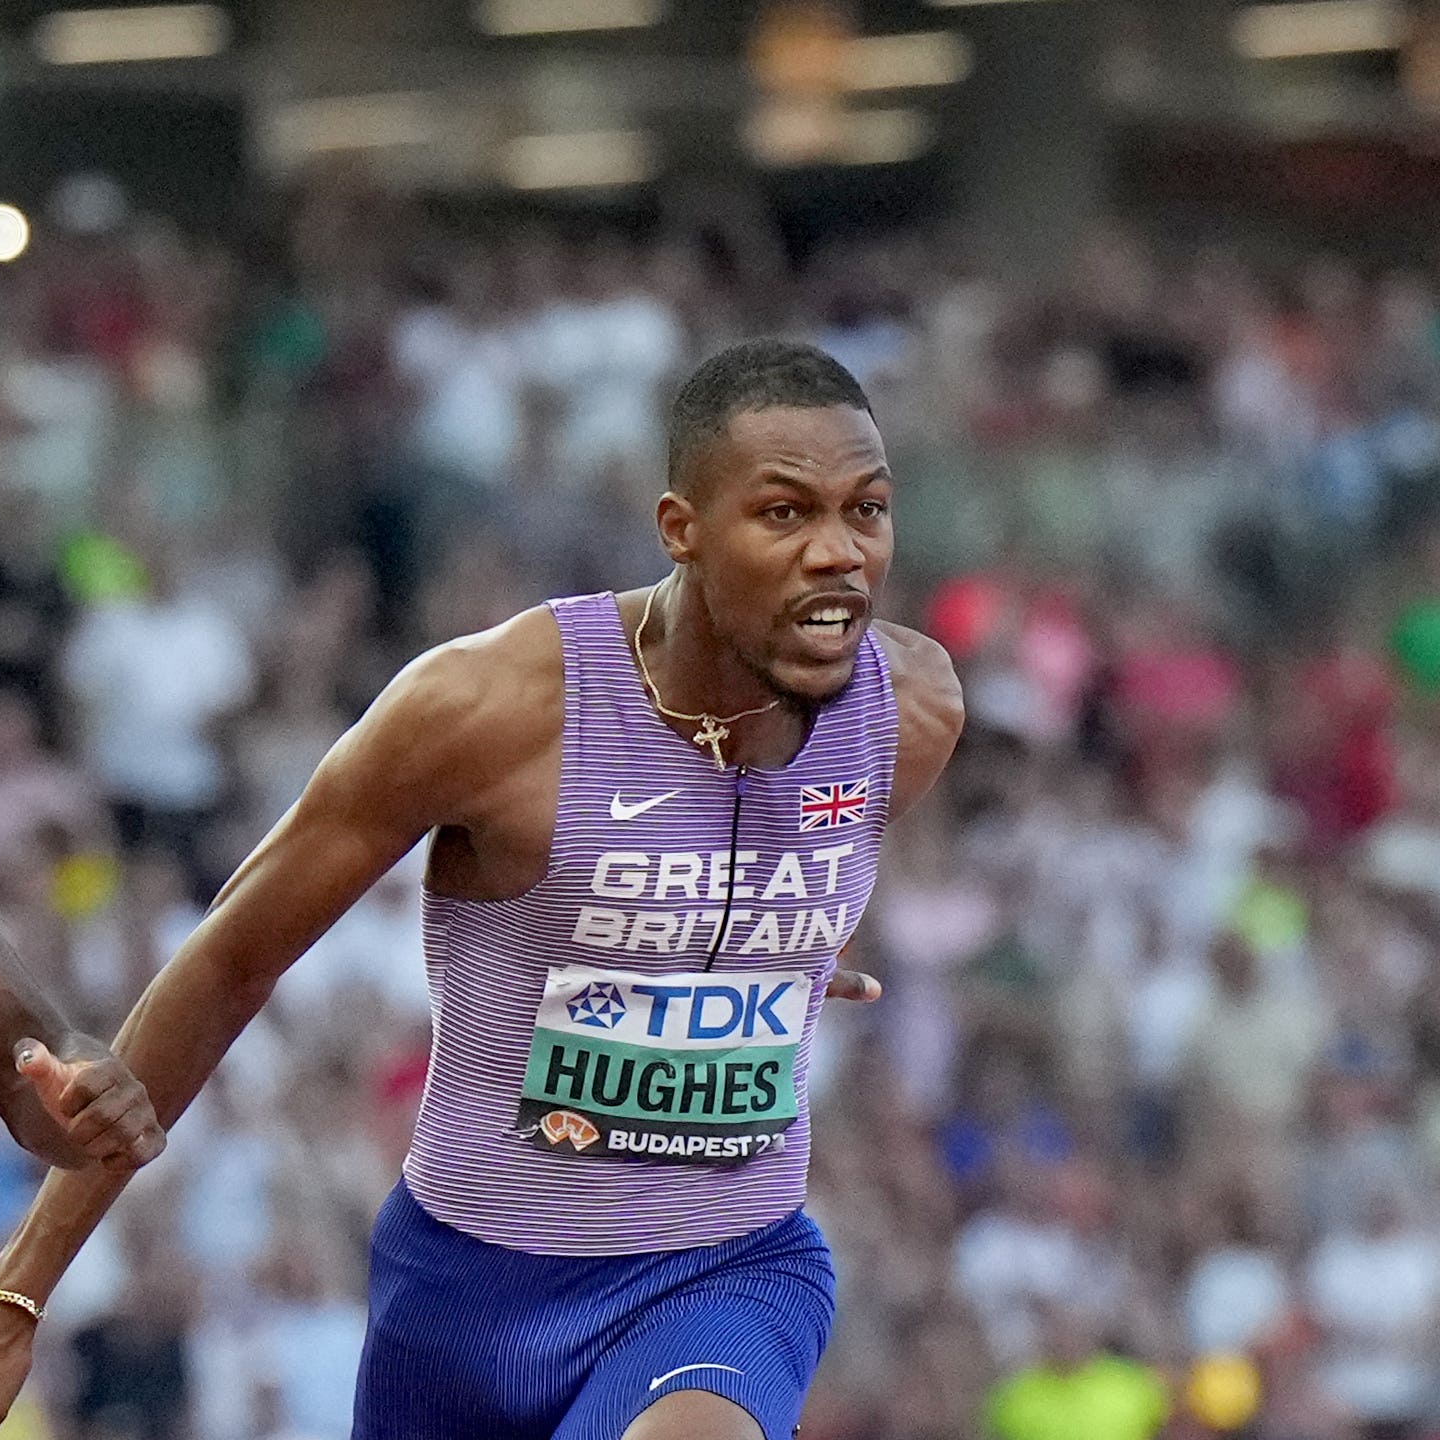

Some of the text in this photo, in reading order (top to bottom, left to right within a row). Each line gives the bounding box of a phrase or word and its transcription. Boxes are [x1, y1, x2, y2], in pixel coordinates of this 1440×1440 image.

[590, 842, 853, 899] GREAT
[571, 904, 847, 955] BRITAIN
[631, 981, 795, 1039] TDK
[543, 1045, 779, 1114] HUGHES
[607, 1130, 752, 1157] BUDAPEST
